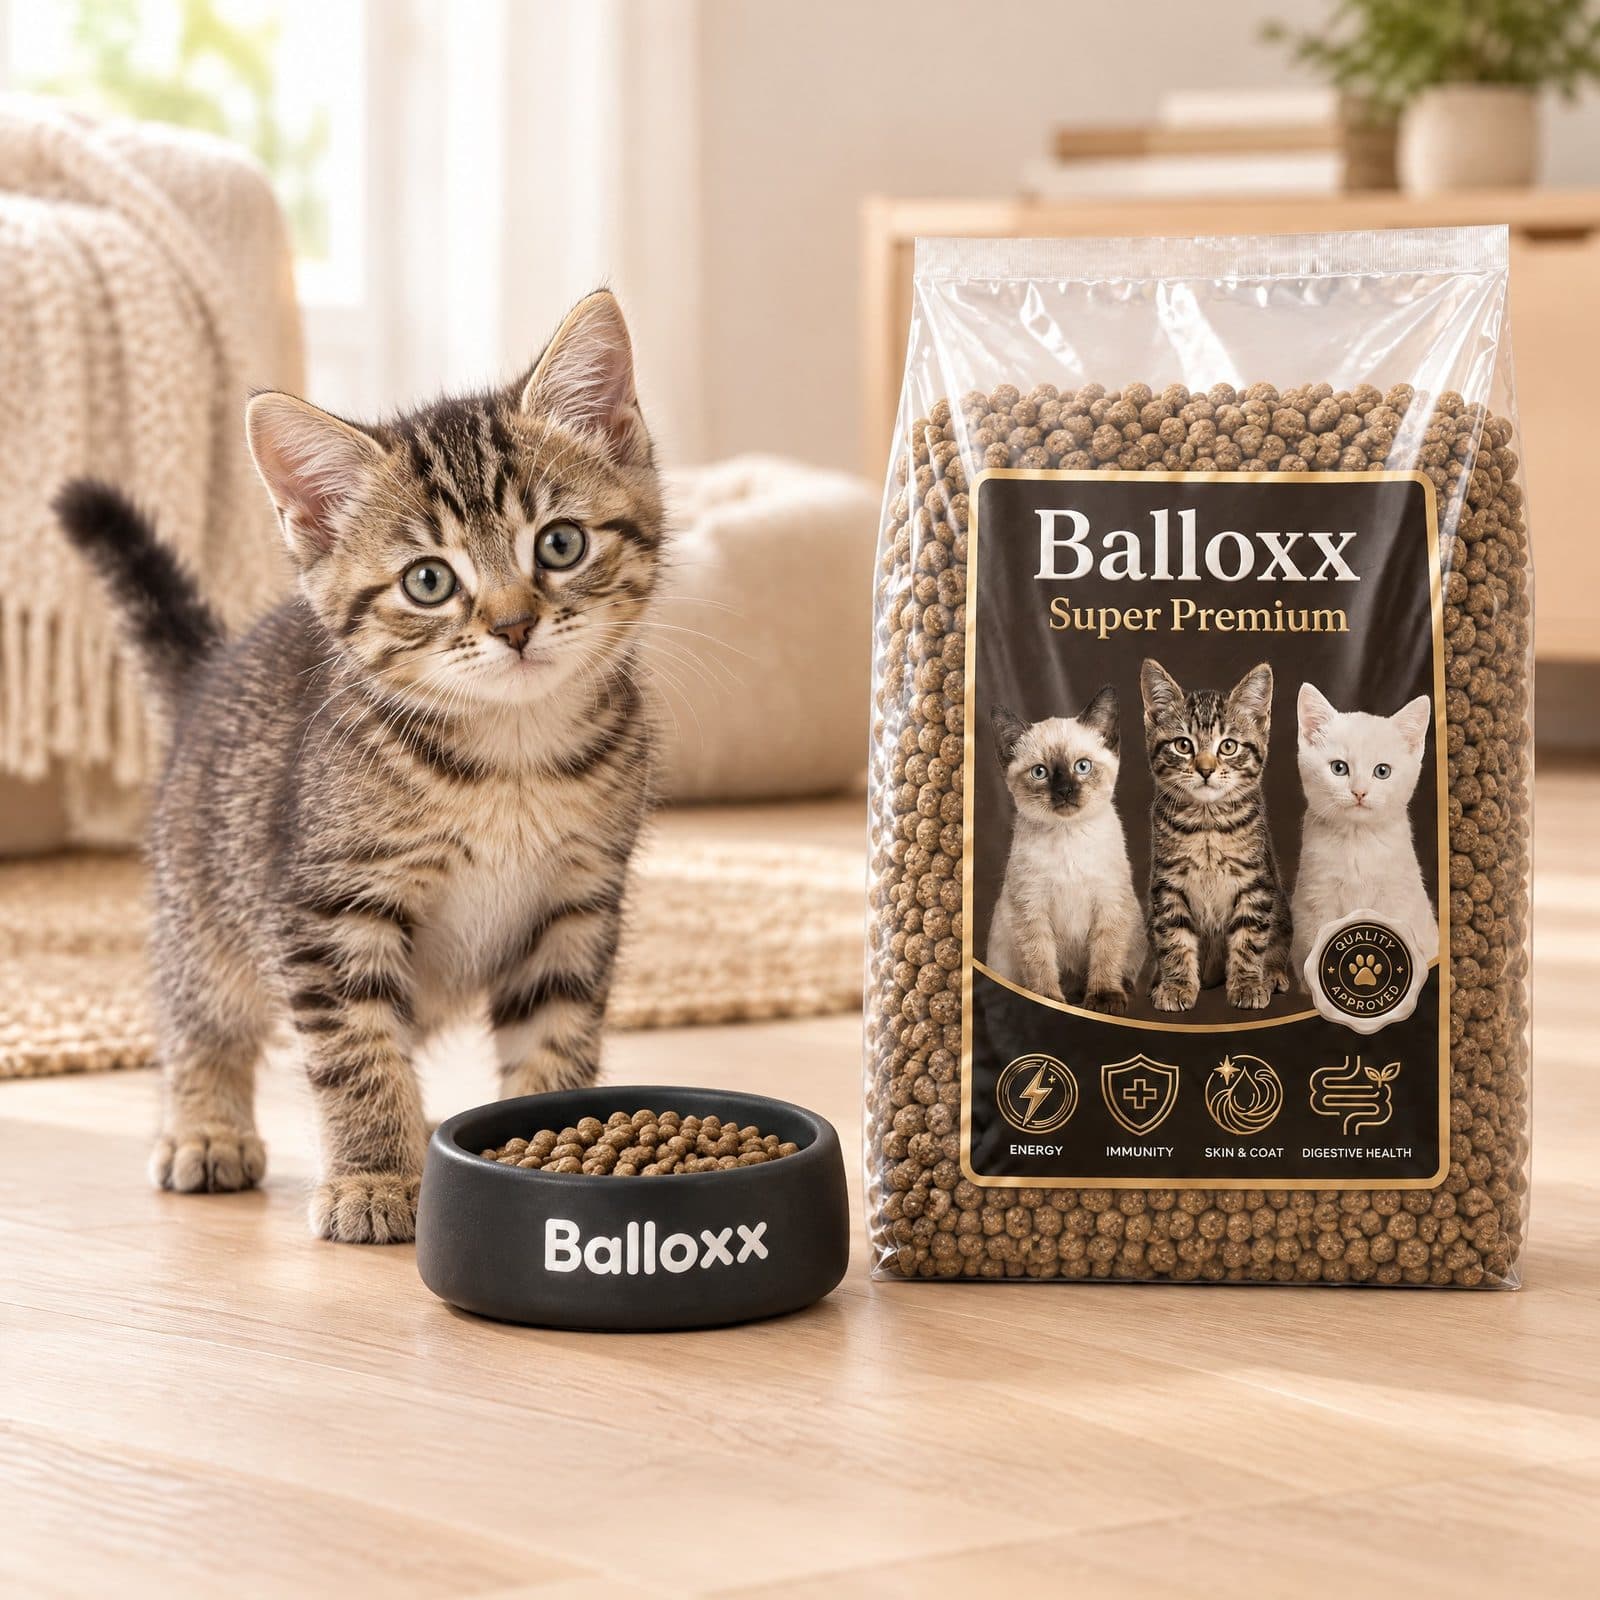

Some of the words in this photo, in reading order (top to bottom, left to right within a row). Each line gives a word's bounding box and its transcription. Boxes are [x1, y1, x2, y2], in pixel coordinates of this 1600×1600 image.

[1034, 509, 1360, 581] Balloxx
[1049, 597, 1161, 639] Super
[1170, 599, 1349, 632] Premium
[1335, 931, 1396, 951] QUALITY
[1331, 985, 1399, 1010] APPROVED
[1009, 1144, 1064, 1156] ENERGY
[1106, 1146, 1174, 1158] IMMUNITY
[1204, 1147, 1234, 1158] SKIN
[1237, 1147, 1247, 1158] &
[1249, 1147, 1285, 1158] COAT
[1302, 1147, 1363, 1159] DIGESTIVE
[1366, 1147, 1412, 1159] HEALTH
[545, 1218, 768, 1275] Balloxx
